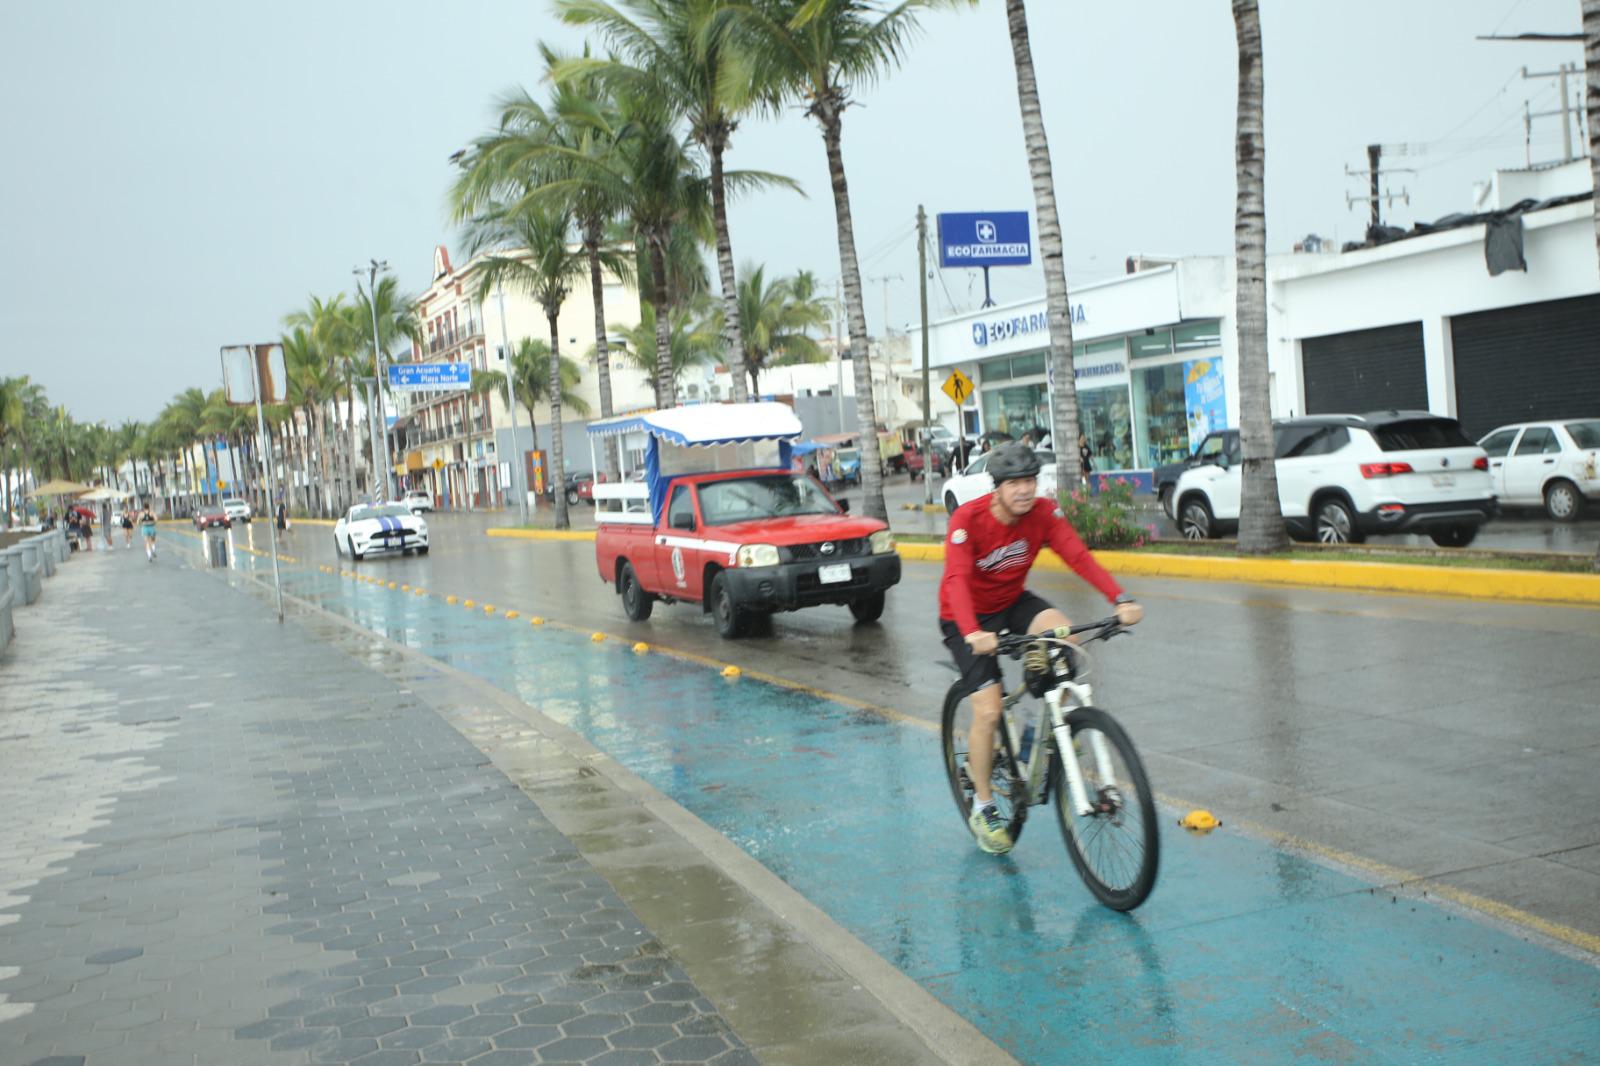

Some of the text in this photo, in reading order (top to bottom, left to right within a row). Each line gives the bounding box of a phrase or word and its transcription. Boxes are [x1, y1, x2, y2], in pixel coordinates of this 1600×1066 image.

[946, 241, 1028, 258] ECOFARMACIA
[989, 303, 1086, 341] ECOFARMIA
[398, 365, 441, 375] Gran Acuario
[421, 374, 458, 384] Playa Norte
